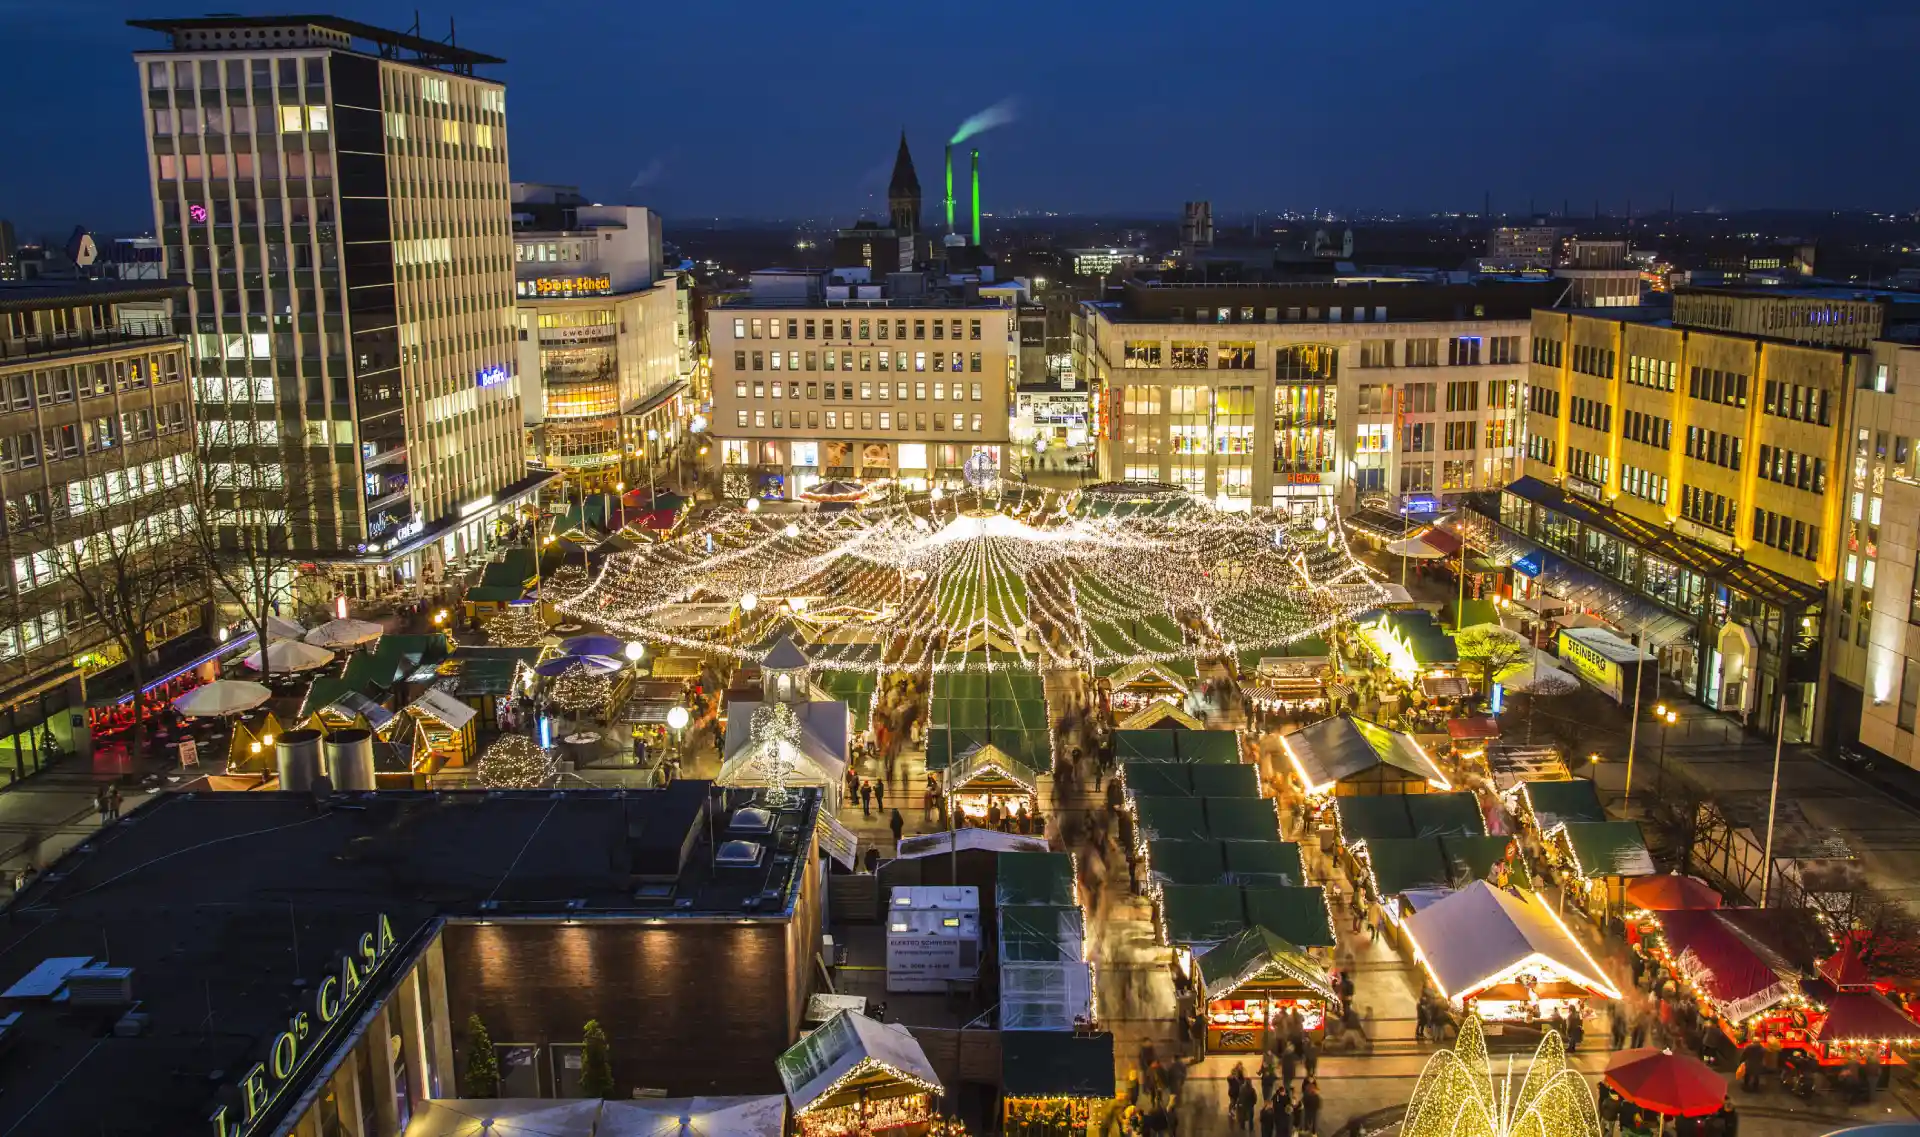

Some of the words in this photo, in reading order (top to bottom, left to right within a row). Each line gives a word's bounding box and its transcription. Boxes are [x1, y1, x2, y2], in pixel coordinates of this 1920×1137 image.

[563, 328, 603, 338] swedex
[1287, 473, 1321, 483] HEMA
[1568, 639, 1606, 671] STEINBERG
[316, 913, 396, 1022] CASA
